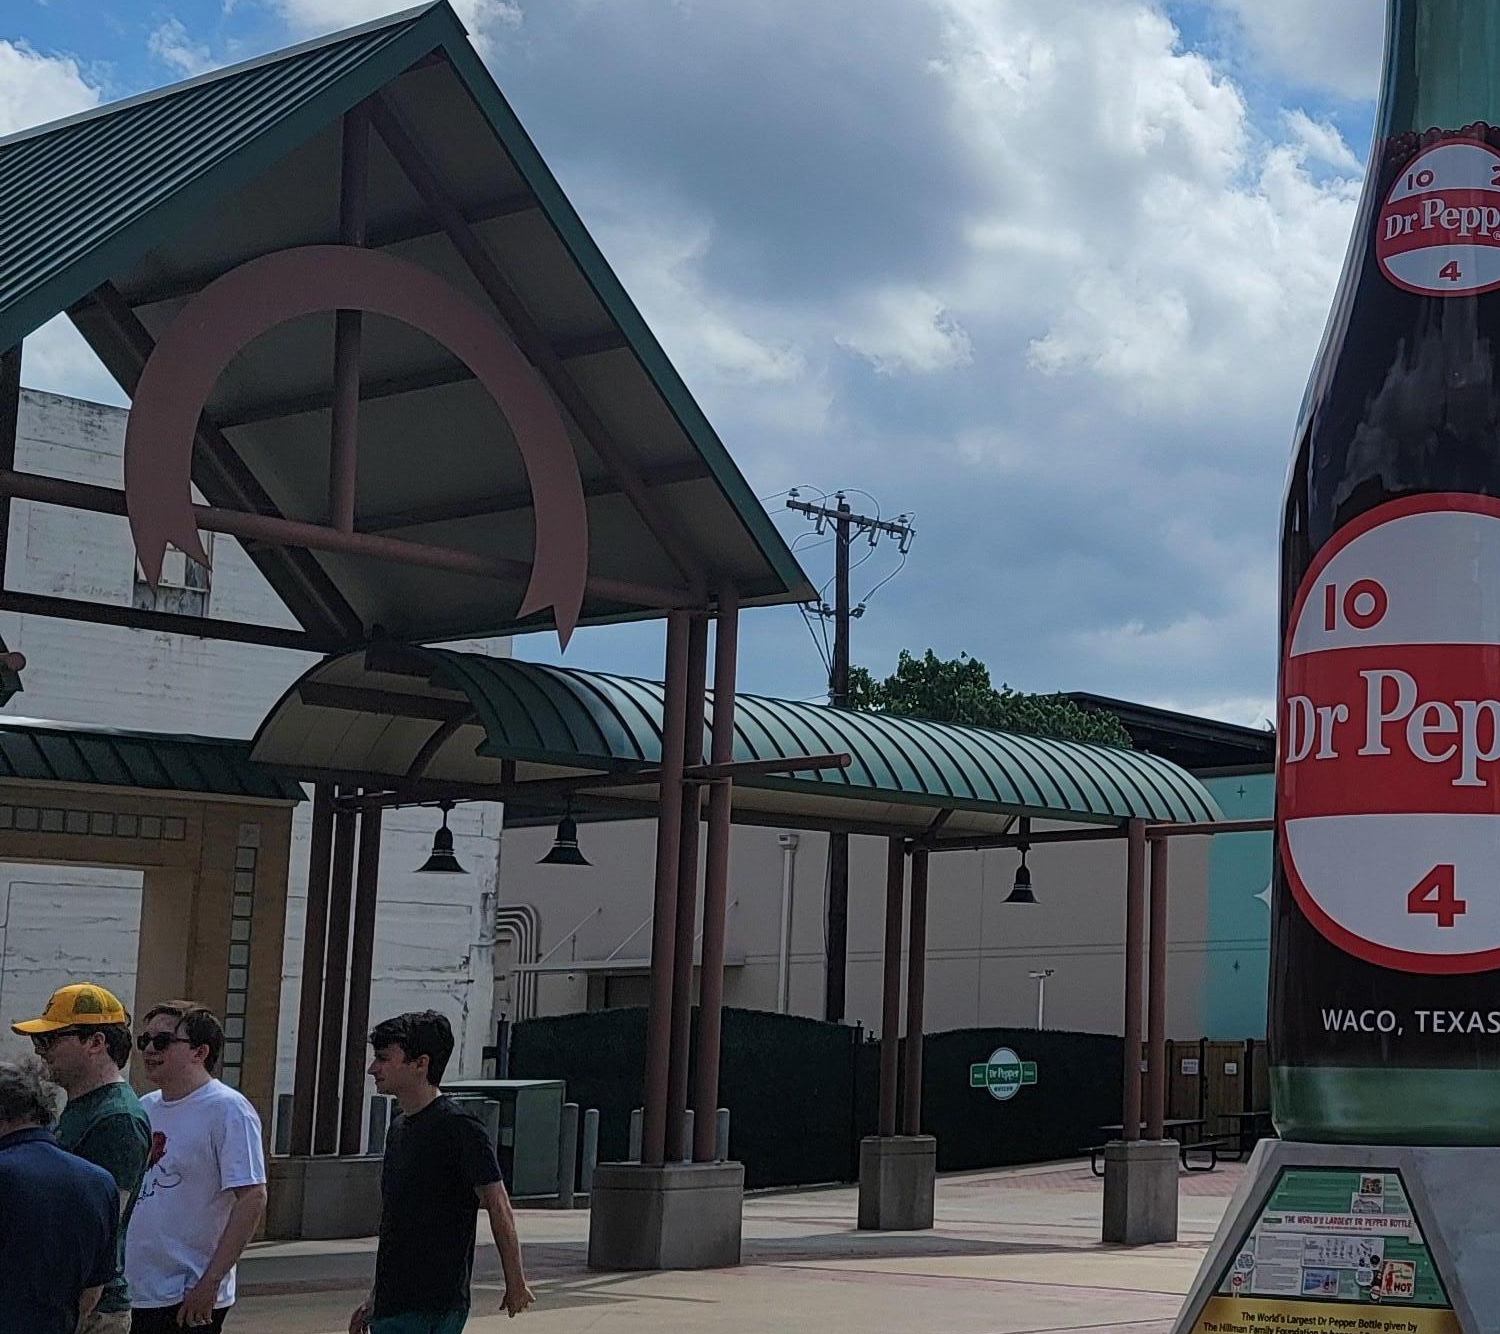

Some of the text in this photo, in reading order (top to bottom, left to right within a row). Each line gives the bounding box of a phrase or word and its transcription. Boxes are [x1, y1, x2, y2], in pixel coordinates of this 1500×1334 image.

[1407, 169, 1435, 190] 10
[1384, 211, 1419, 241] Dr
[1438, 260, 1462, 282] 4
[1323, 578, 1388, 632] 10
[1285, 695, 1349, 764] Dr
[1407, 863, 1467, 928] 4
[1321, 1008, 1404, 1036] WACO,
[1393, 1282, 1412, 1293] HOT
[1204, 1322, 1218, 1332] The
[1219, 1323, 1248, 1334] Hillman
[1241, 1312, 1418, 1333] The World's Largest Dr Pepper Bottle given by
